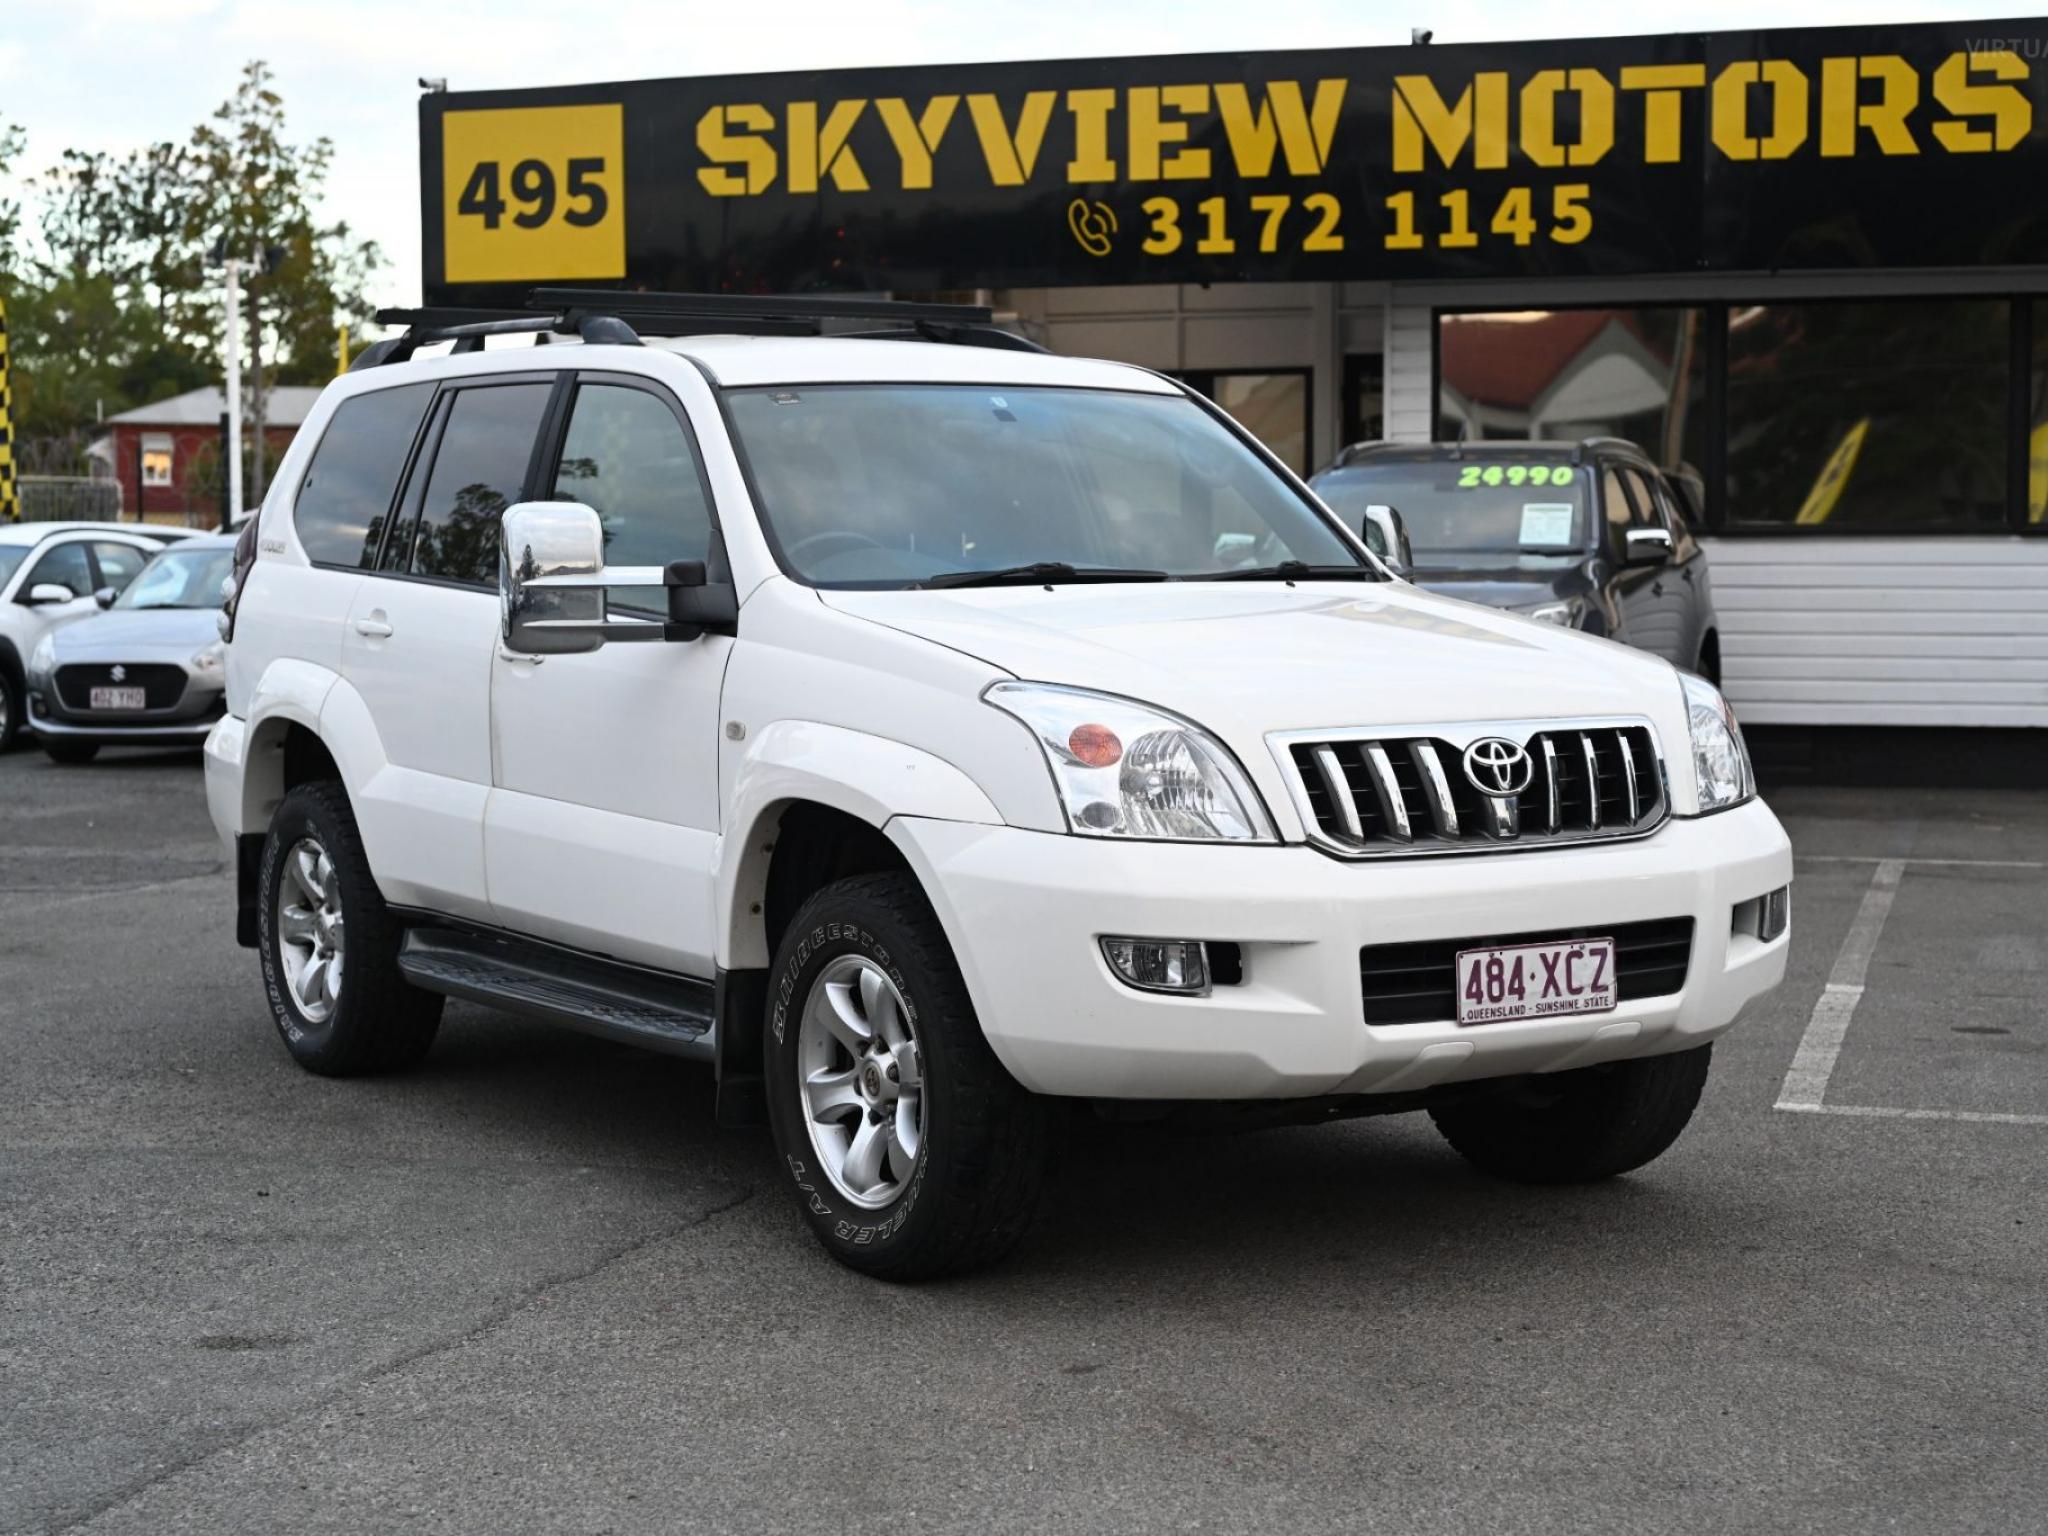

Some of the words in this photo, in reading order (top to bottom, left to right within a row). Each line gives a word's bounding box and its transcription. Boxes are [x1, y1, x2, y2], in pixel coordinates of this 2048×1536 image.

[696, 78, 1348, 196] SKYVIEW
[1392, 51, 2032, 173] MOTORS
[458, 157, 609, 230] 495
[1142, 193, 1344, 255] 3172
[1385, 184, 1593, 249] 1145
[1458, 465, 1574, 487] 24990
[1467, 1006, 1526, 1021] QUEENSLAND
[1535, 1000, 1579, 1014] SUNSHINE
[1583, 995, 1609, 1008] STATE
